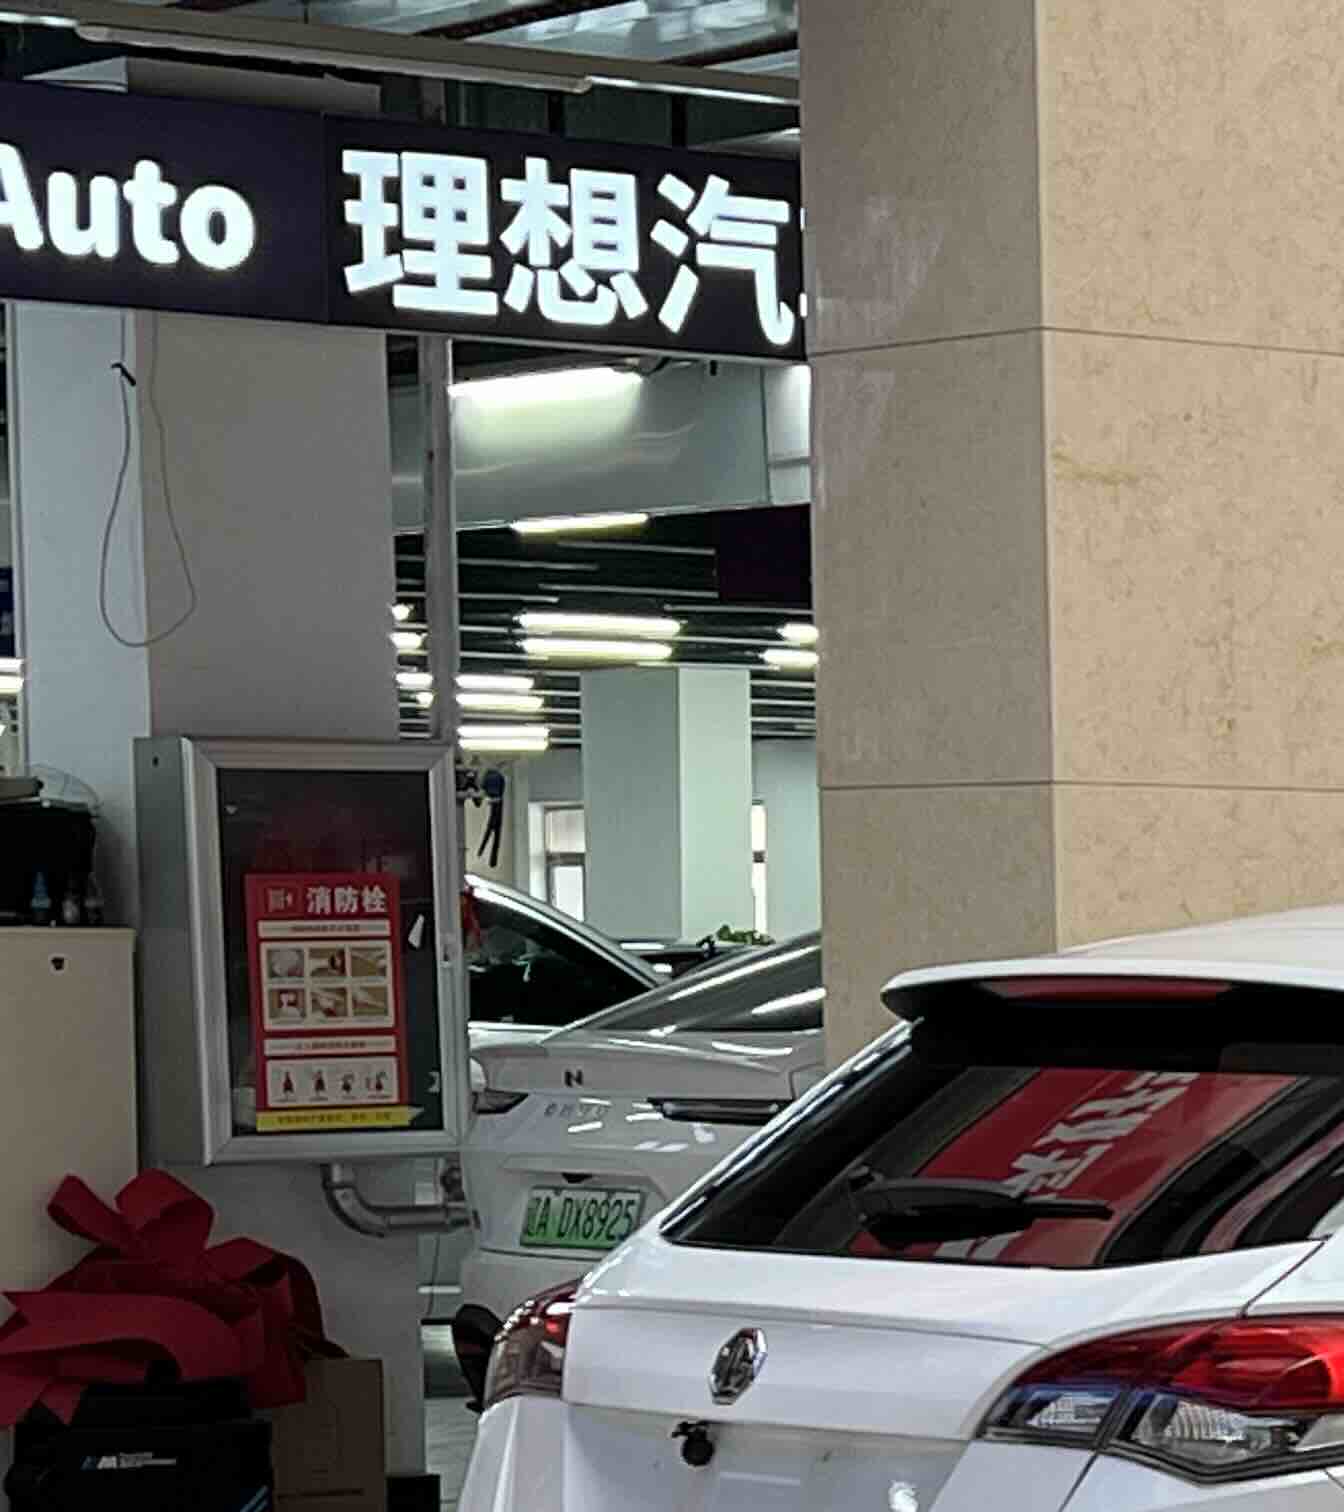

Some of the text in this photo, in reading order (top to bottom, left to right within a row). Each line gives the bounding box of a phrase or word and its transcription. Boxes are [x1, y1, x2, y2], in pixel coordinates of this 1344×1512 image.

[342, 149, 807, 346] 理想汽
[306, 884, 388, 915] 消防栓
